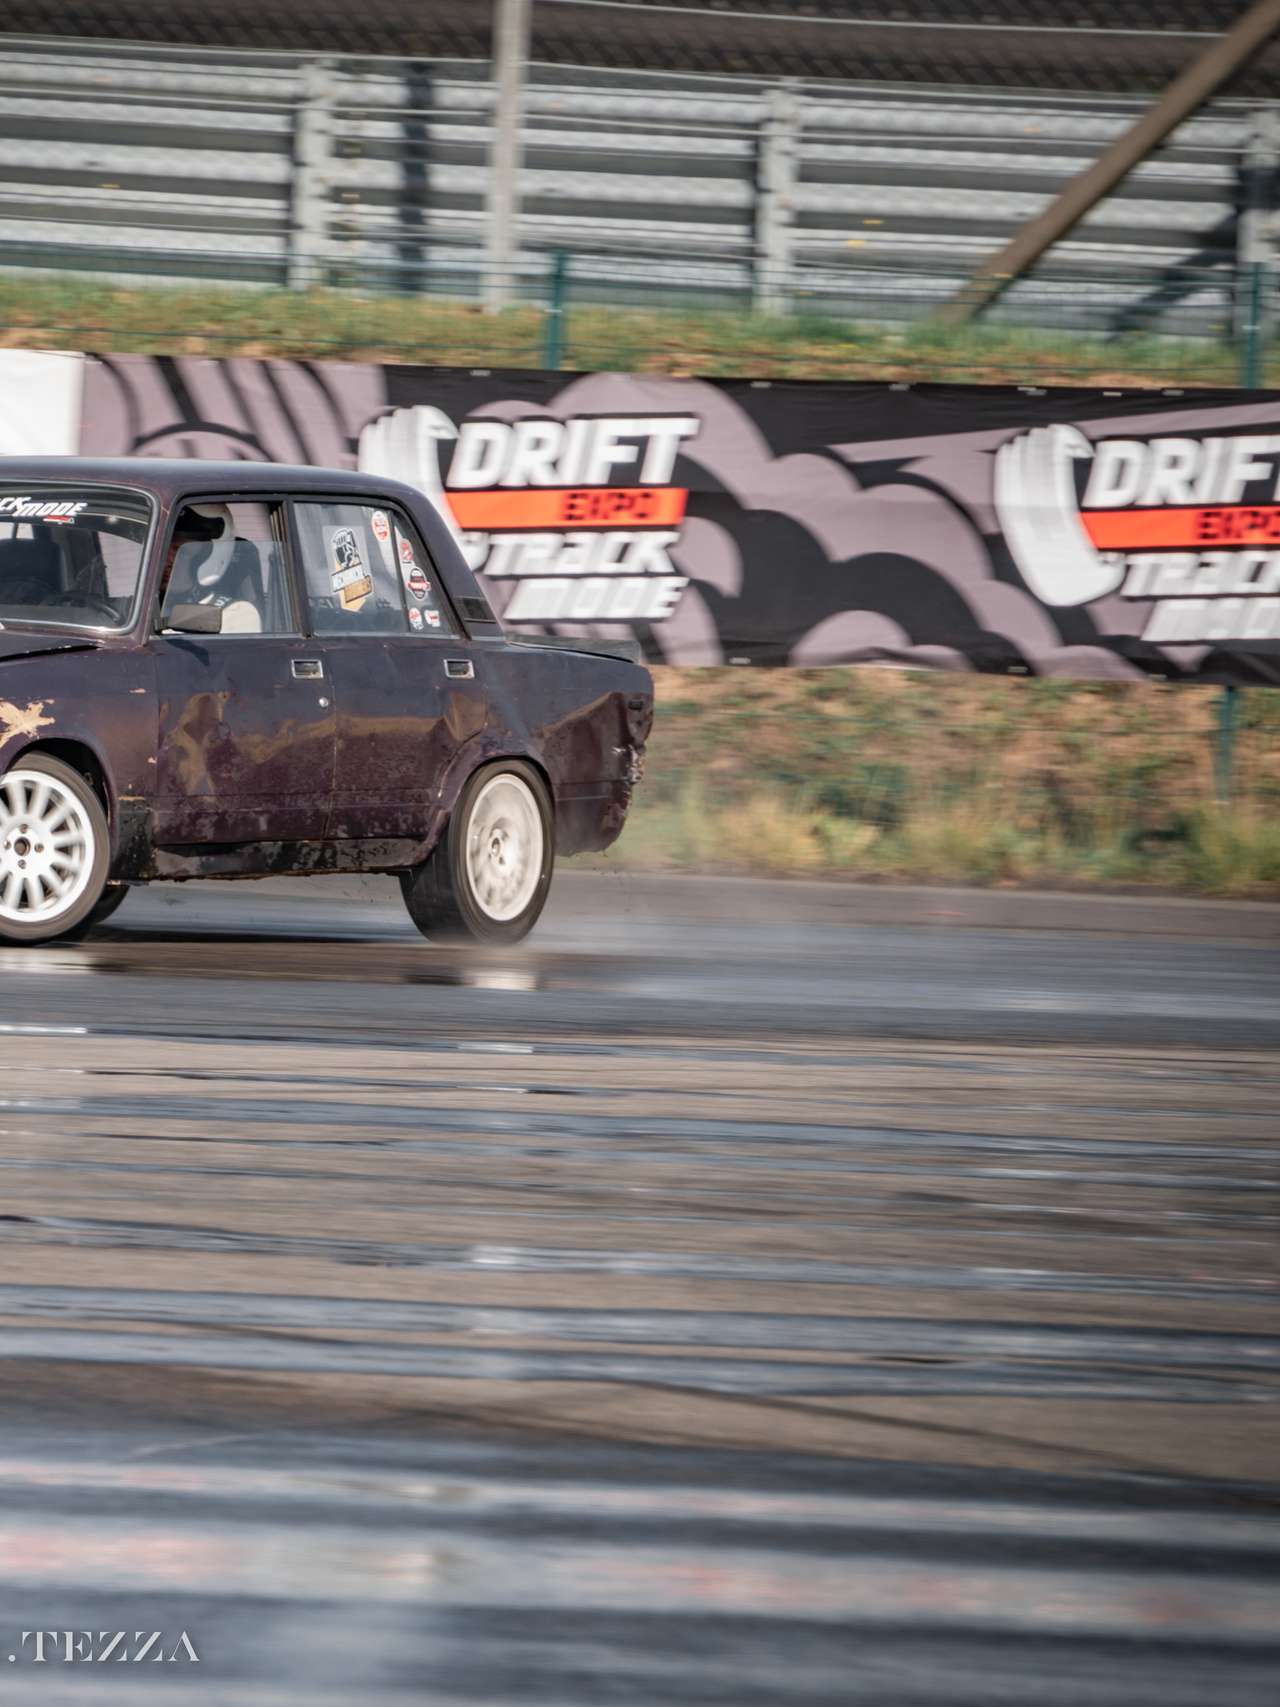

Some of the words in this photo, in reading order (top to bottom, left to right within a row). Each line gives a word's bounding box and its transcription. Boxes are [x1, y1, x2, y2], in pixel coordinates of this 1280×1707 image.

[446, 417, 700, 487] DRIFT
[1081, 435, 1280, 507] DRIF
[562, 492, 658, 520] EXPO
[1121, 551, 1280, 596] TRAC
